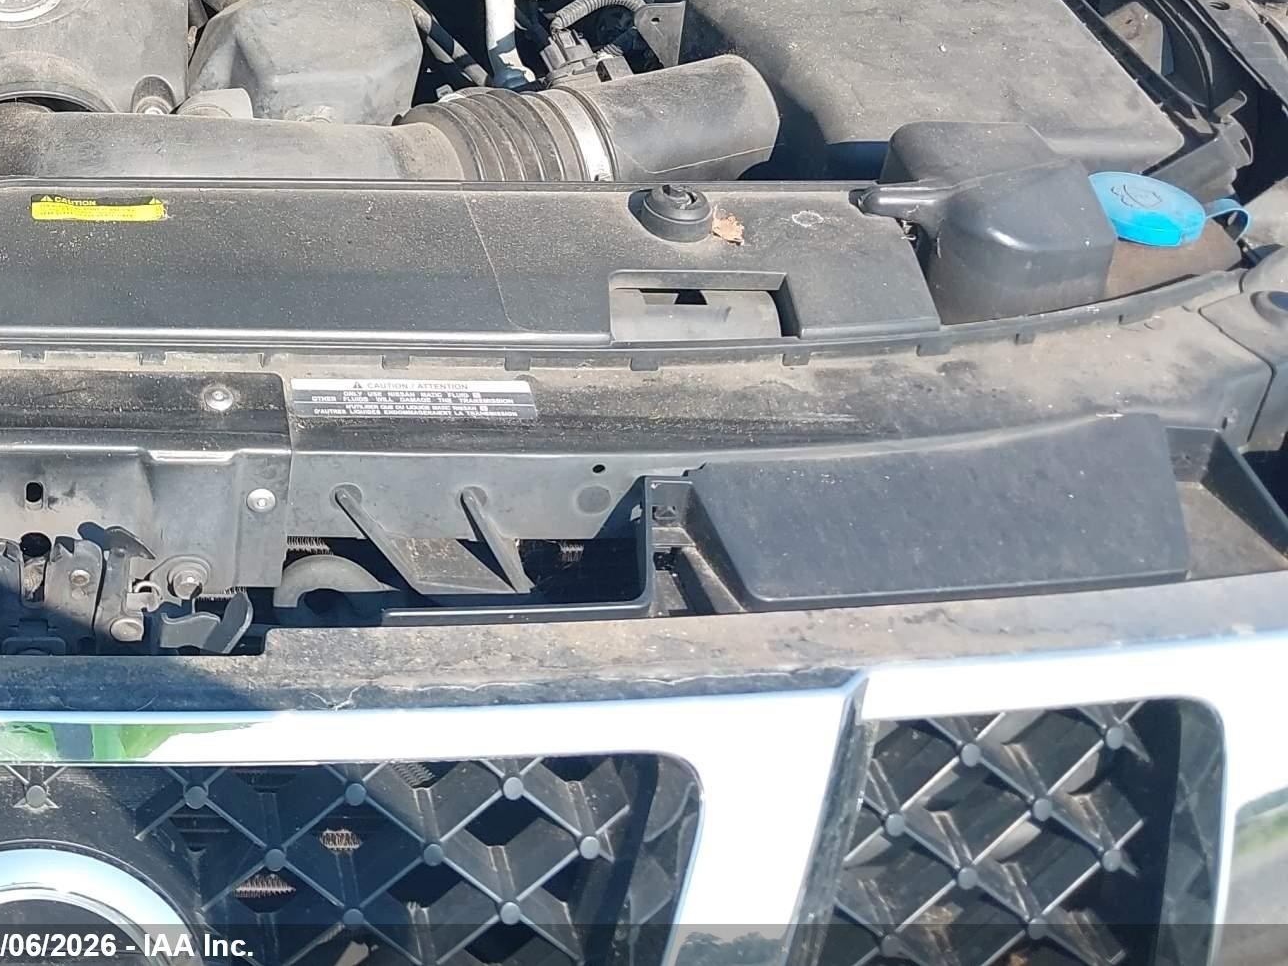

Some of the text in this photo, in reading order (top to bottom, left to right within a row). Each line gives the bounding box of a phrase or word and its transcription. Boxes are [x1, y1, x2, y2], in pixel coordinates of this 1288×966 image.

[54, 196, 97, 206] CAUTION
[367, 382, 409, 390] CAUTION
[417, 382, 468, 390] ATTENTION
